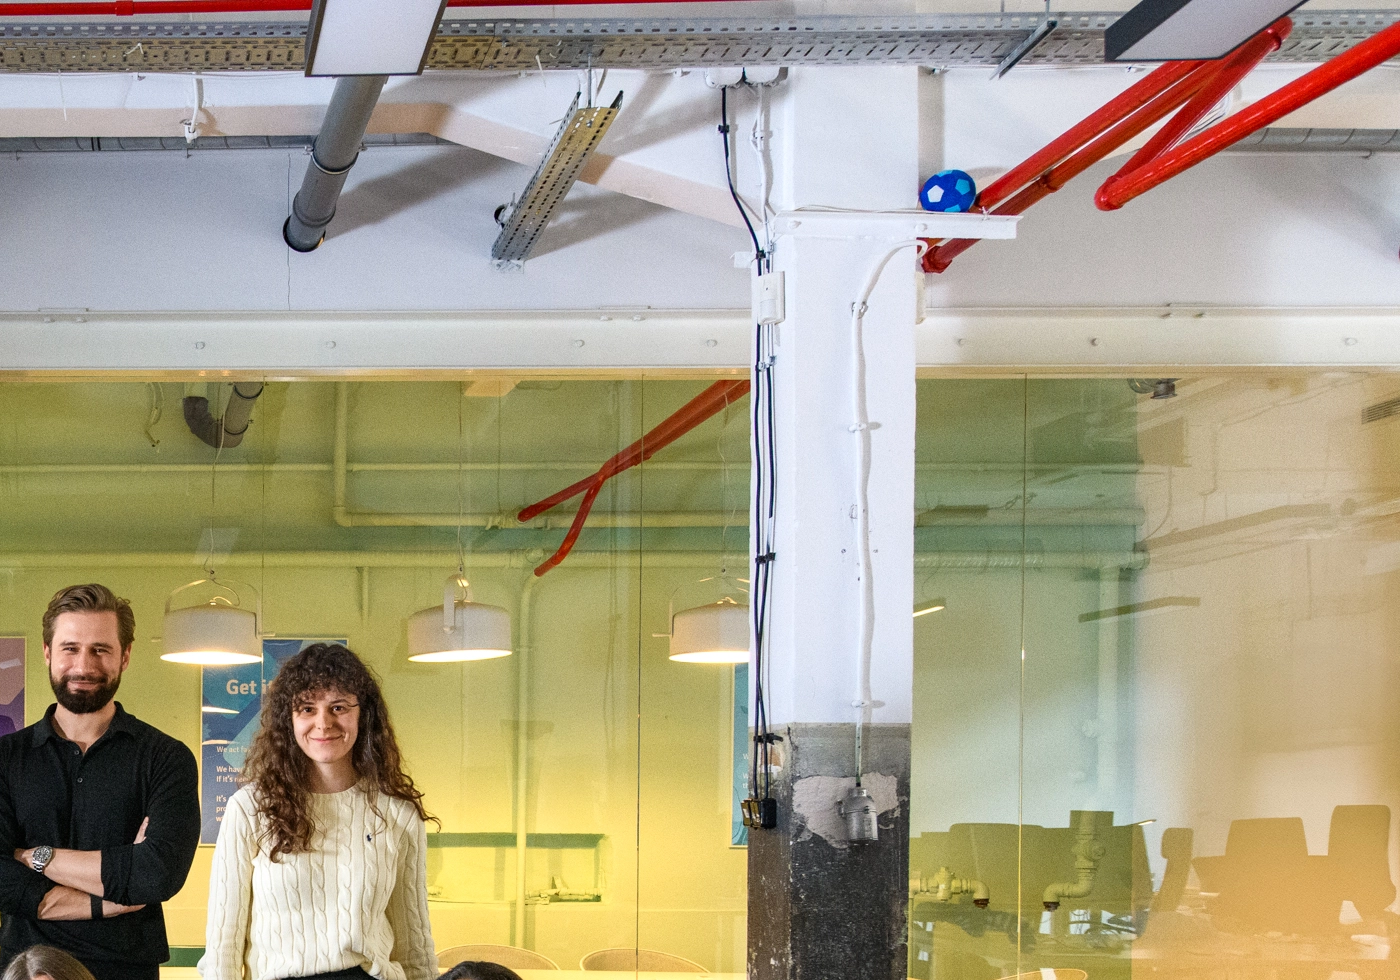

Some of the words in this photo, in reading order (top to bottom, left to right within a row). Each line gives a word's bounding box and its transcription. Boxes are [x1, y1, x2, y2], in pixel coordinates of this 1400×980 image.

[226, 679, 257, 695] Get
[216, 775, 222, 783] If
[222, 775, 233, 783] it's
